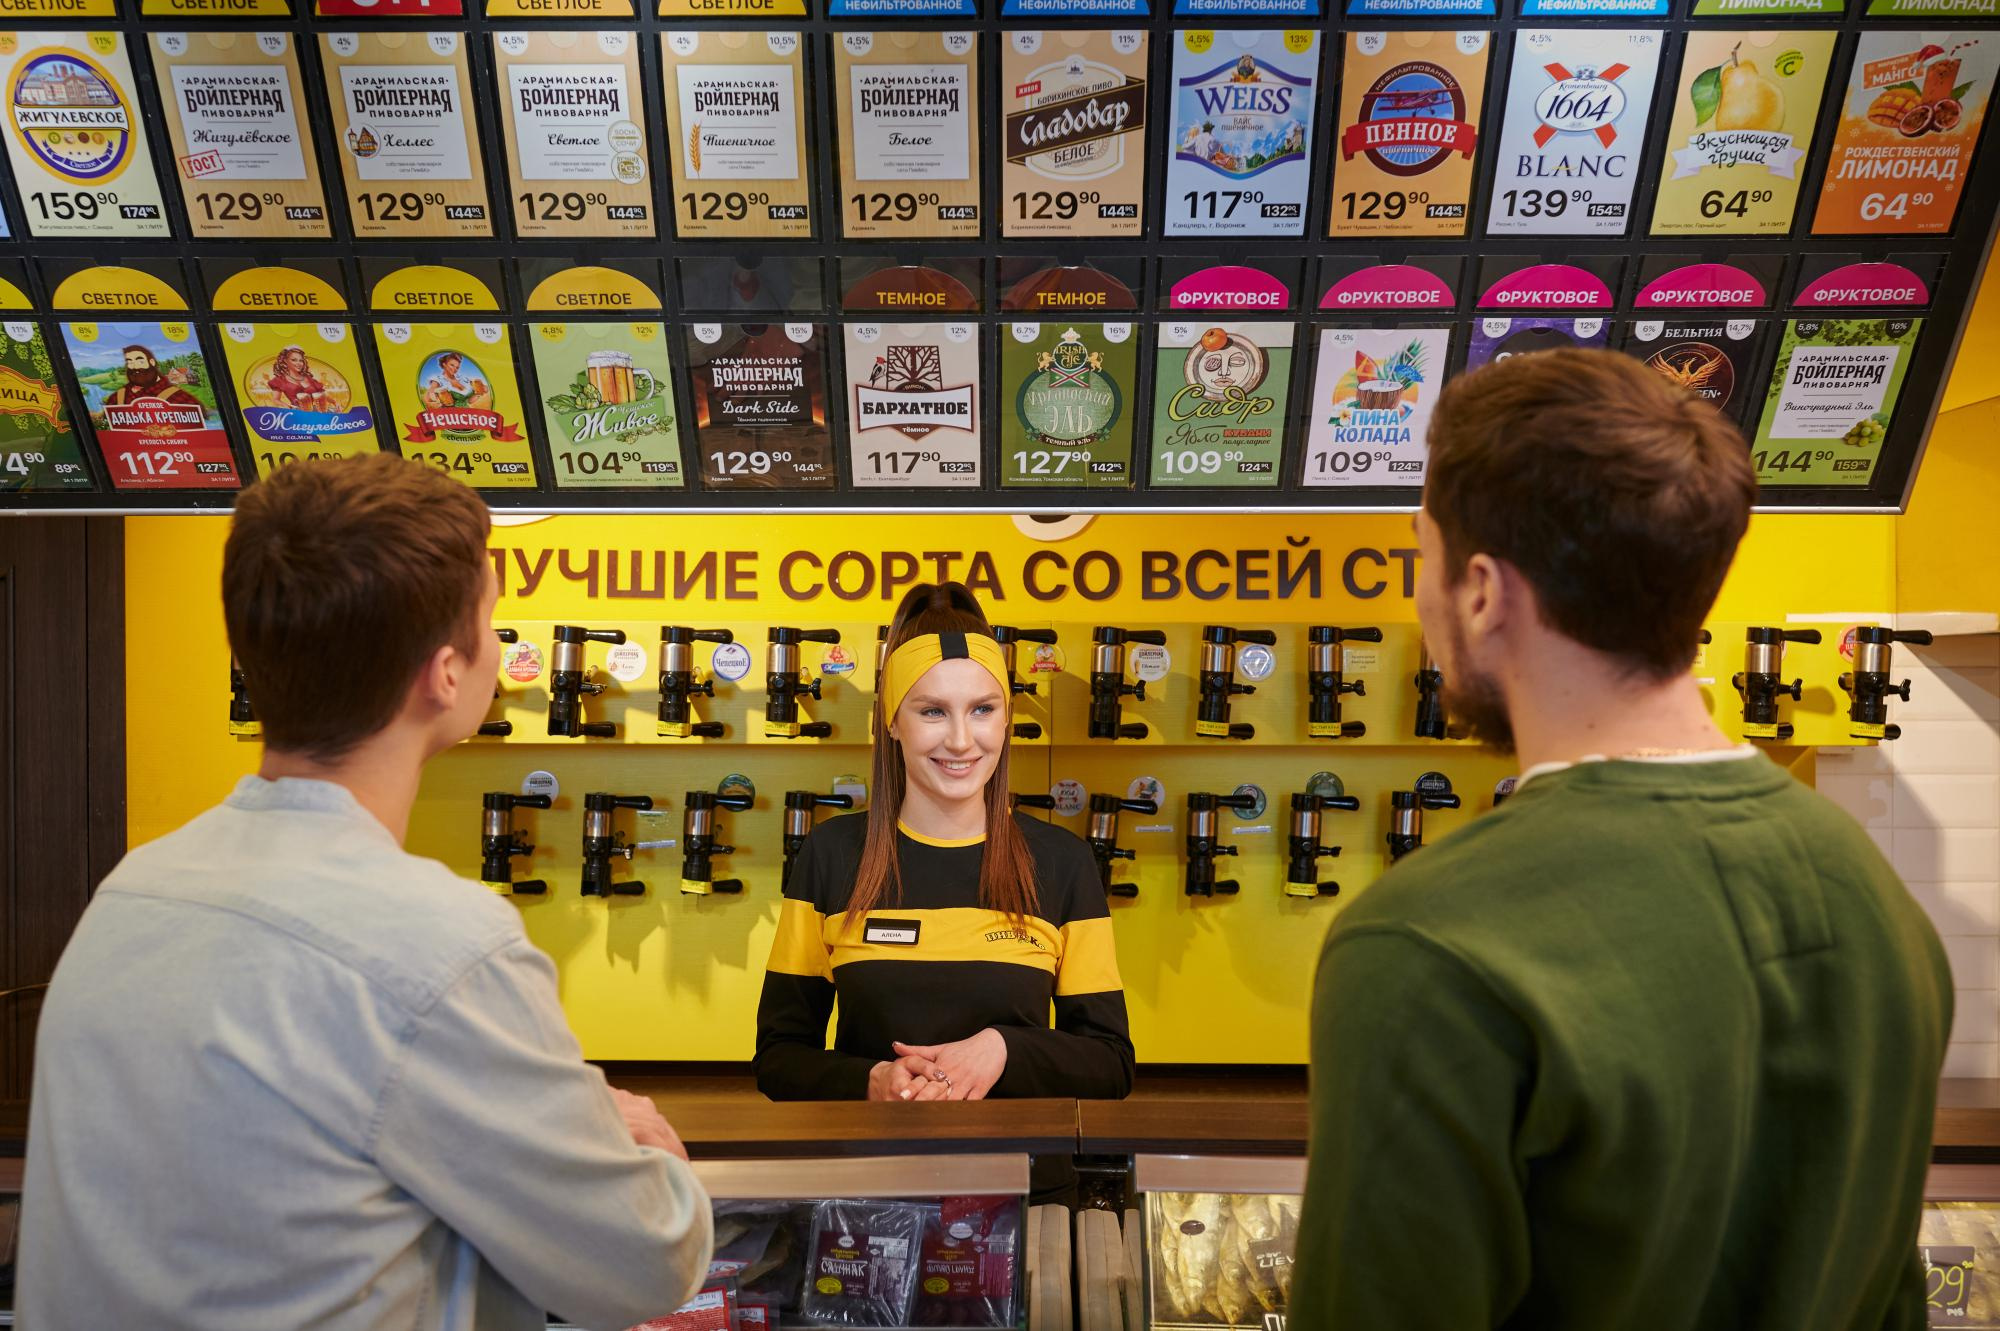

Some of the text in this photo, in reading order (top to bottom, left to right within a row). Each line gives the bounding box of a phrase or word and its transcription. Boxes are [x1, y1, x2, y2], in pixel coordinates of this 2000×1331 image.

[845, 0, 962, 10] НЕФИЛЬТРОВАННОЕ
[1019, 0, 1135, 10] НЕФИЛЬТРОВАННОЕ
[1189, 0, 1306, 10] НЕФИЛЬТРОВАННОЕ
[1365, 0, 1483, 10] НЕФИЛЬТРОВАННОЕ
[1538, 0, 1656, 10] НЕФИЛЬТРОВАННОЕ
[1717, 0, 1823, 10] ЛИМОНАД
[1892, 0, 1996, 11] ЛИМОНАД
[185, 76, 276, 85] АРАМИЛЬСКАЯ
[355, 77, 445, 86] АРАМИЛЬСКАЯ
[523, 76, 613, 85] АРАМИЛЬСКАЯ
[864, 76, 954, 85] АРАМИЛЬСКАЯ
[1092, 80, 1112, 93] ПИВО
[184, 87, 285, 113] БОЙЛЕРНАЯ
[353, 87, 452, 113] БОЙЛЕРНАЯ
[520, 85, 620, 112] БОЙЛЕРНАЯ
[695, 89, 780, 112] БОЙЛЕРНАЯ
[861, 85, 959, 112] БОЙЛЕРНАЯ
[1195, 86, 1293, 116] WEISS
[1546, 91, 1613, 120] 1664
[19, 111, 125, 124] ЖИГУЛЕВСКОЕ
[202, 110, 274, 118] ПИВОВАРНЯ
[369, 109, 441, 118] ПИВОВАРНЯ
[536, 109, 608, 117] ПИВОВАРНЯ
[875, 109, 947, 117] ПИВОВАРНЯ
[548, 133, 600, 146] Светлое
[889, 133, 933, 146] Белое
[1365, 123, 1458, 144] ПЕННОЕ
[384, 135, 434, 147] Хеллес
[1054, 143, 1095, 163] БЕЛОЕ
[187, 155, 217, 174] ГОСТ
[1516, 155, 1626, 178] BLANC
[1836, 160, 1957, 181] ЛИМОНАД
[82, 293, 158, 305] СВЕТЛОЕ
[240, 293, 318, 306] СВЕТЛОЕ
[395, 292, 474, 305] СВЕТЛОЕ
[556, 293, 632, 306] СВЕТЛОЕ
[877, 292, 946, 305] ТЕМНОЕ
[1037, 292, 1106, 305] ТЕМНОЕ
[1178, 292, 1280, 305] ФРУКТОВОЕ
[1338, 290, 1440, 304] ФРУКТОВОЕ
[1497, 290, 1599, 304] ФРУКТОВОЕ
[1651, 289, 1754, 303] ФРУКТОВОЕ
[1814, 288, 1917, 302] ФРУКТОВОЕ
[1664, 327, 1723, 339] БЕЛЬГИЯ
[715, 357, 799, 365] АРАМИЛЬСКАЯ
[712, 367, 803, 387] БОЙЛЕРНАЯ
[1792, 363, 1886, 386] БОЙЛЕРНАЯ
[1803, 381, 1869, 389] ПИВОВАРНЯ
[723, 400, 800, 414] Dark Side
[862, 401, 968, 415] БАРХАТНОЕ
[1168, 384, 1275, 425] Сидр
[111, 410, 200, 425] ДЯДЬКА КРЕПЫШ
[258, 410, 368, 435] Жигулевское
[424, 411, 497, 430] Чешское
[1044, 405, 1093, 434] ЭЛЬ
[1351, 410, 1399, 426] ПИНА
[573, 405, 659, 444] Живое
[1334, 427, 1411, 445] КОЛАДА
[778, 549, 1005, 601] СОРТА
[1022, 549, 1122, 601] СО
[1142, 536, 1322, 600] ВСЕЙ
